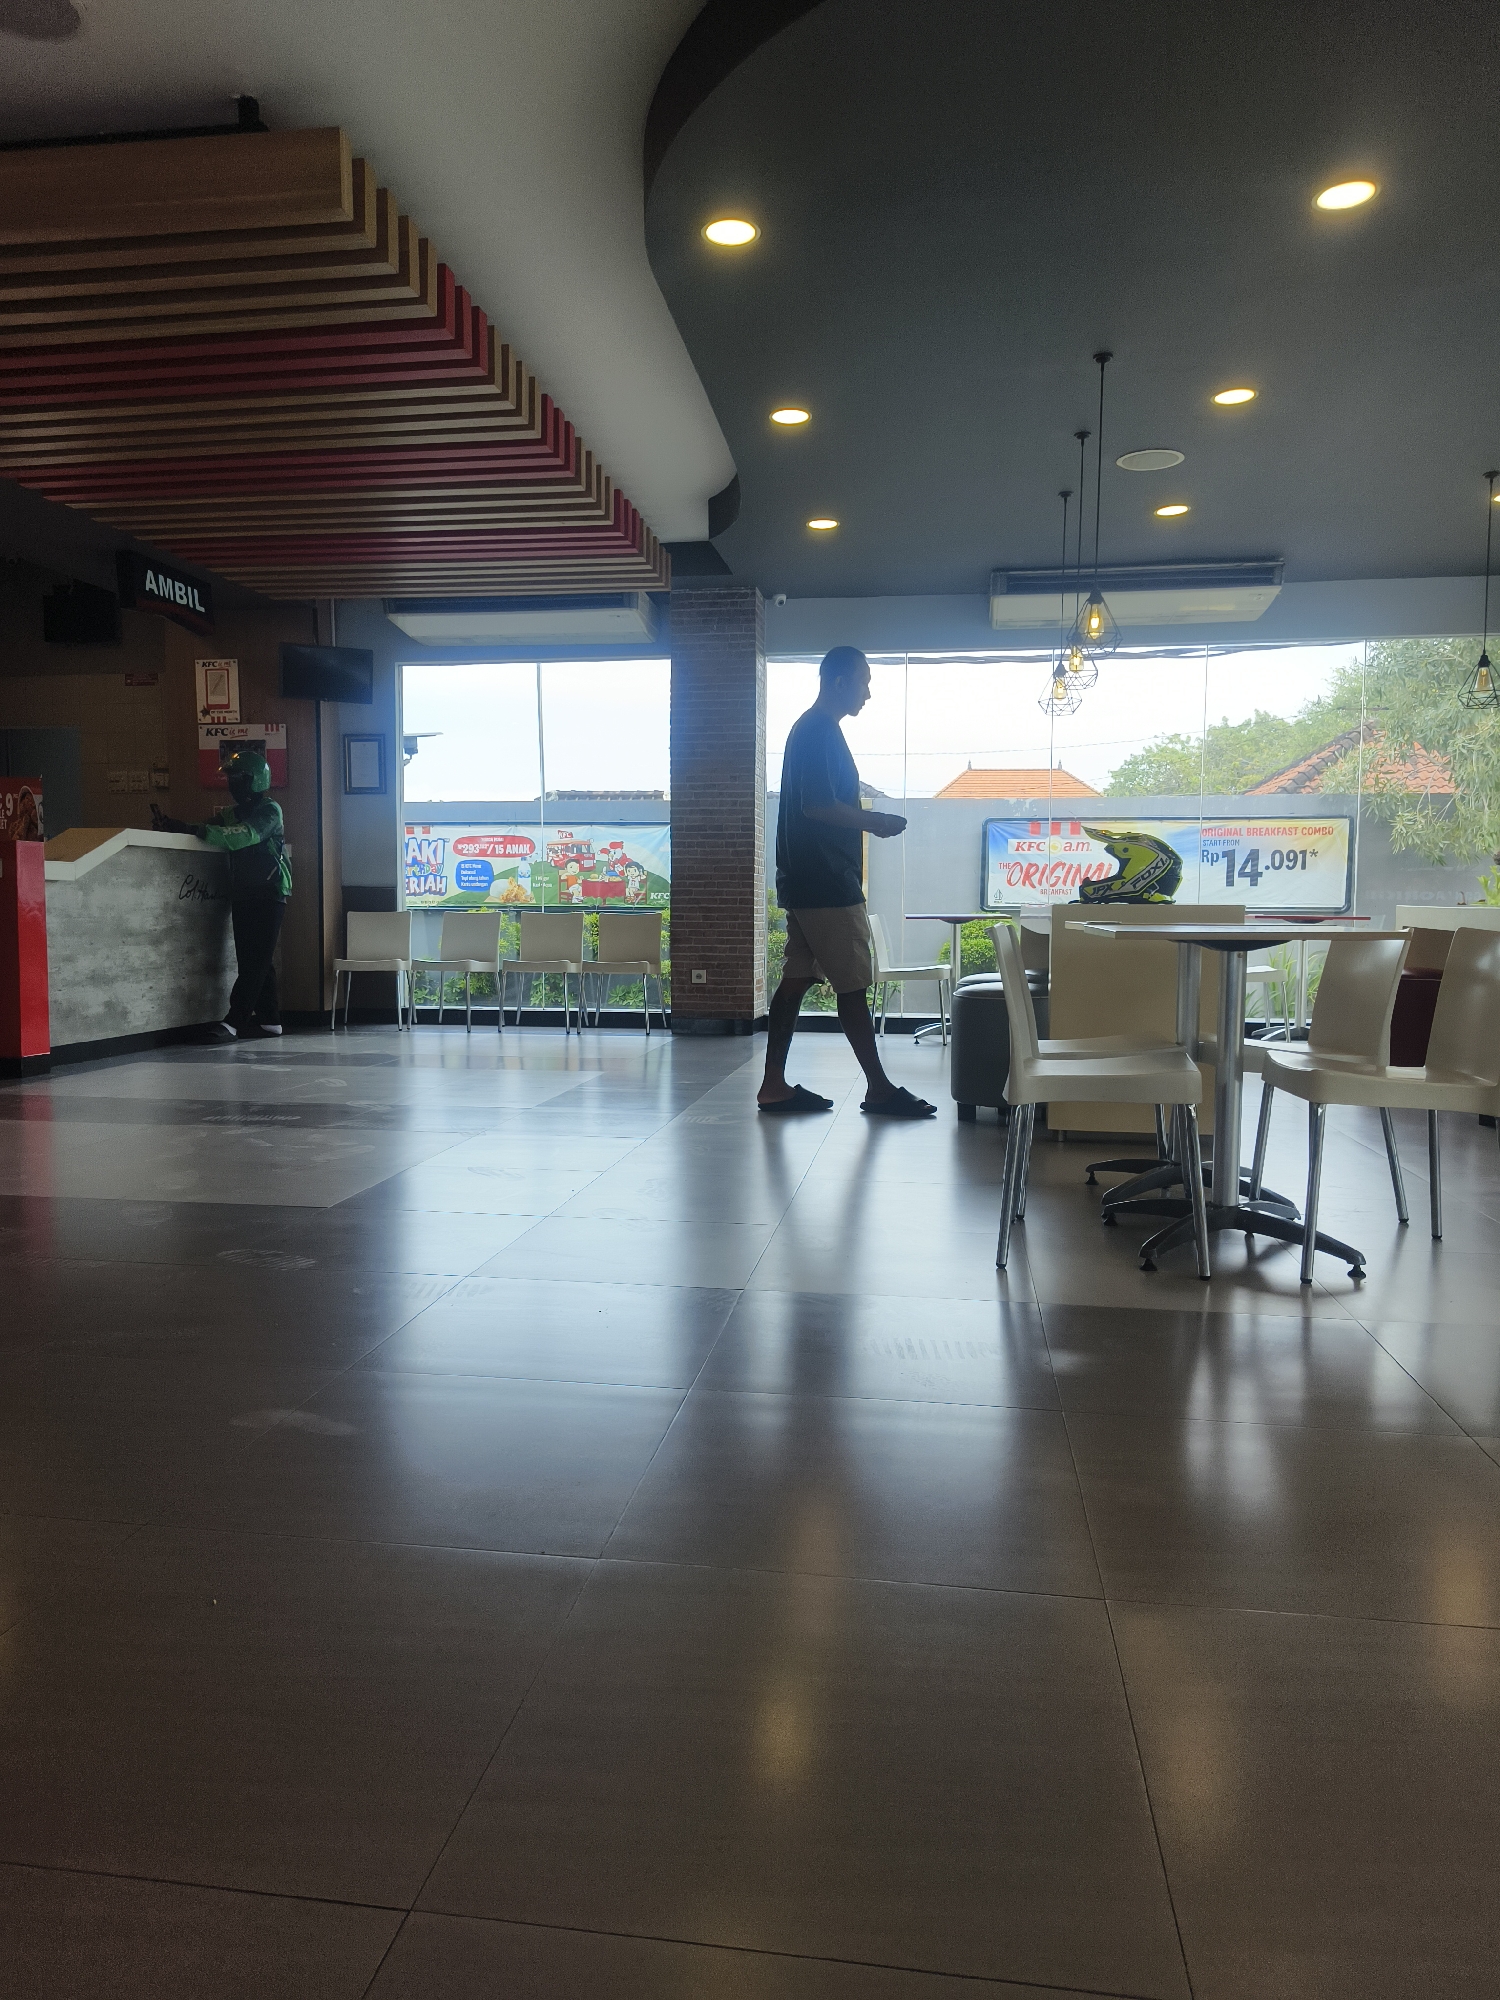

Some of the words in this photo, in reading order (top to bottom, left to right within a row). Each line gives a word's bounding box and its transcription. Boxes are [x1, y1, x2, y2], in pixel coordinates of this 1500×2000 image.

[145, 569, 206, 613] AMBIL
[206, 727, 229, 737] KFC
[5, 792, 14, 817] 9
[1201, 826, 1244, 837] ORIGINAL
[1245, 826, 1299, 837] BREAKFAST
[1301, 826, 1334, 837] COMBO
[1013, 841, 1046, 852] KFC
[1202, 839, 1222, 847] START
[1222, 839, 1241, 847] FROM
[405, 838, 445, 865] AKI
[998, 862, 1012, 870] THE
[1039, 888, 1073, 896] BREAKFAST
[1090, 883, 1115, 897] JPX
[649, 892, 671, 901] KFC
